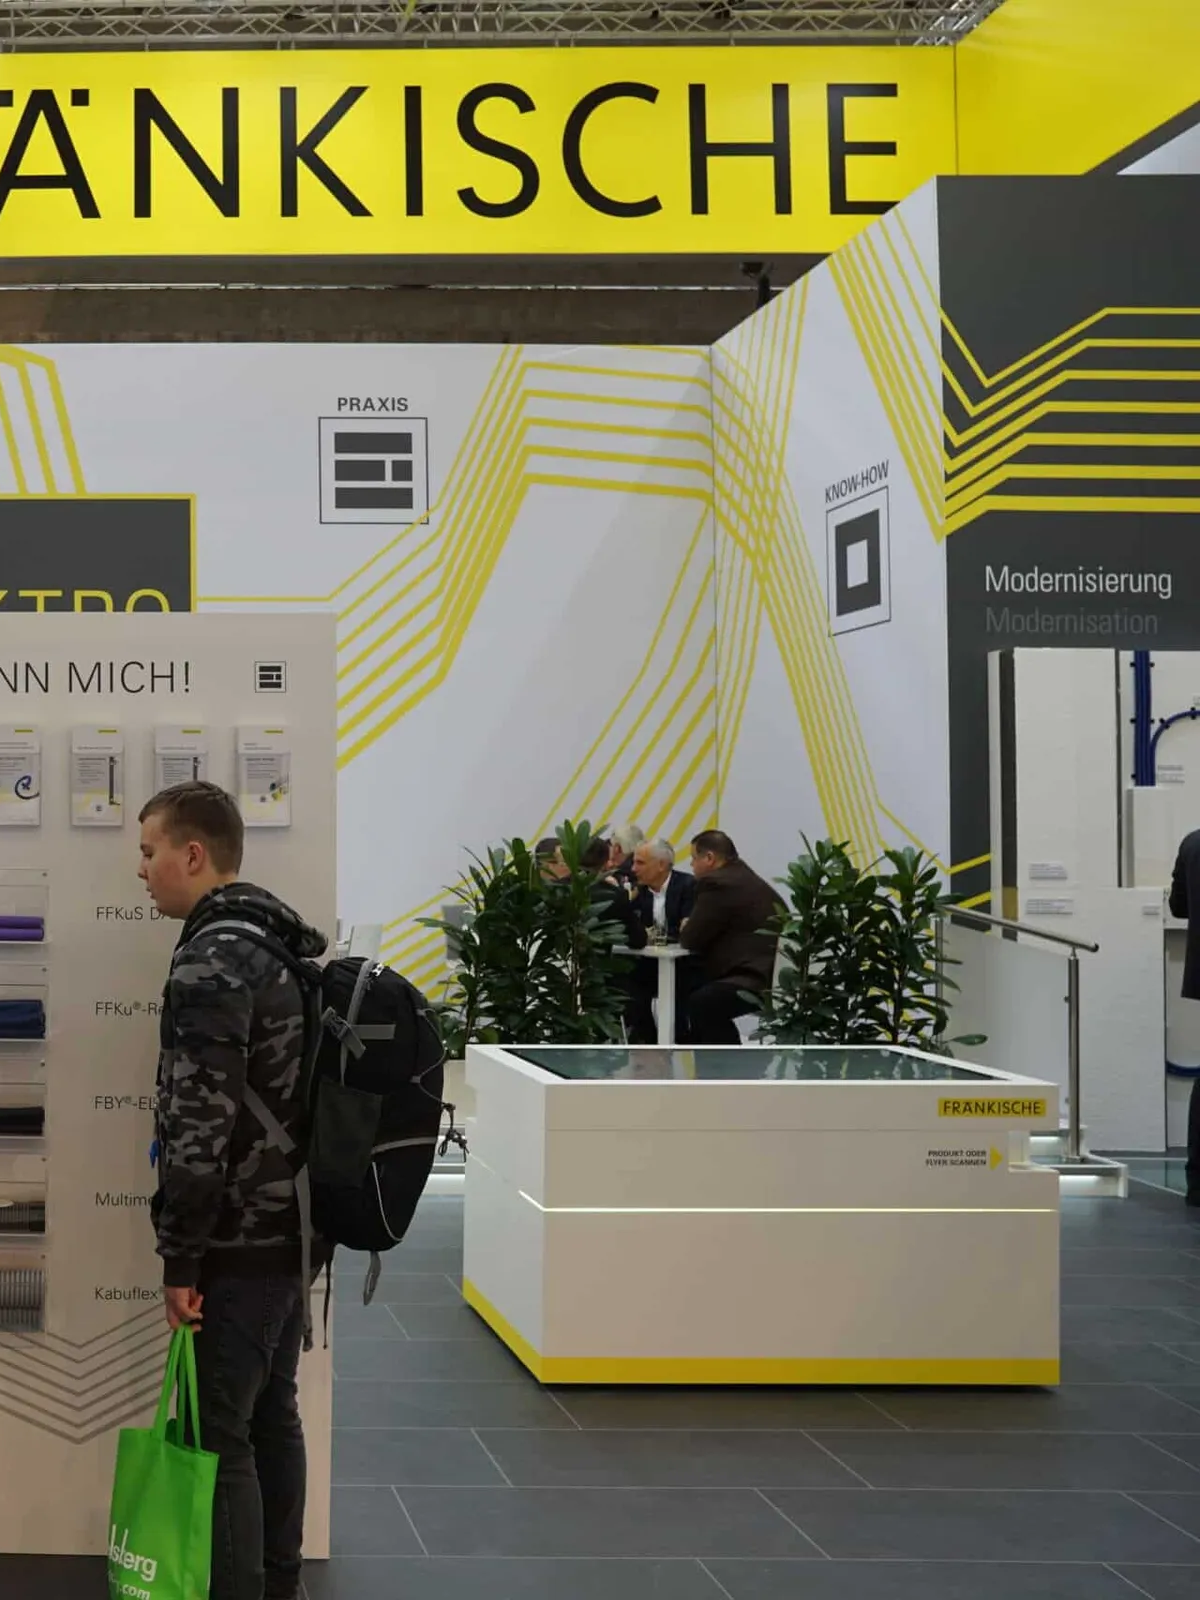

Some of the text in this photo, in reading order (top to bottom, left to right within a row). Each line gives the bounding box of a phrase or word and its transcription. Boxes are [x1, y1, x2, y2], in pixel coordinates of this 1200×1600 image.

[337, 397, 408, 412] PRAXIS
[825, 459, 889, 503] KNOW-HOW
[985, 565, 1172, 600] Modernisierung
[986, 606, 1158, 635] Modernisation
[68, 661, 191, 694] MICH!
[96, 906, 144, 920] FFKuS
